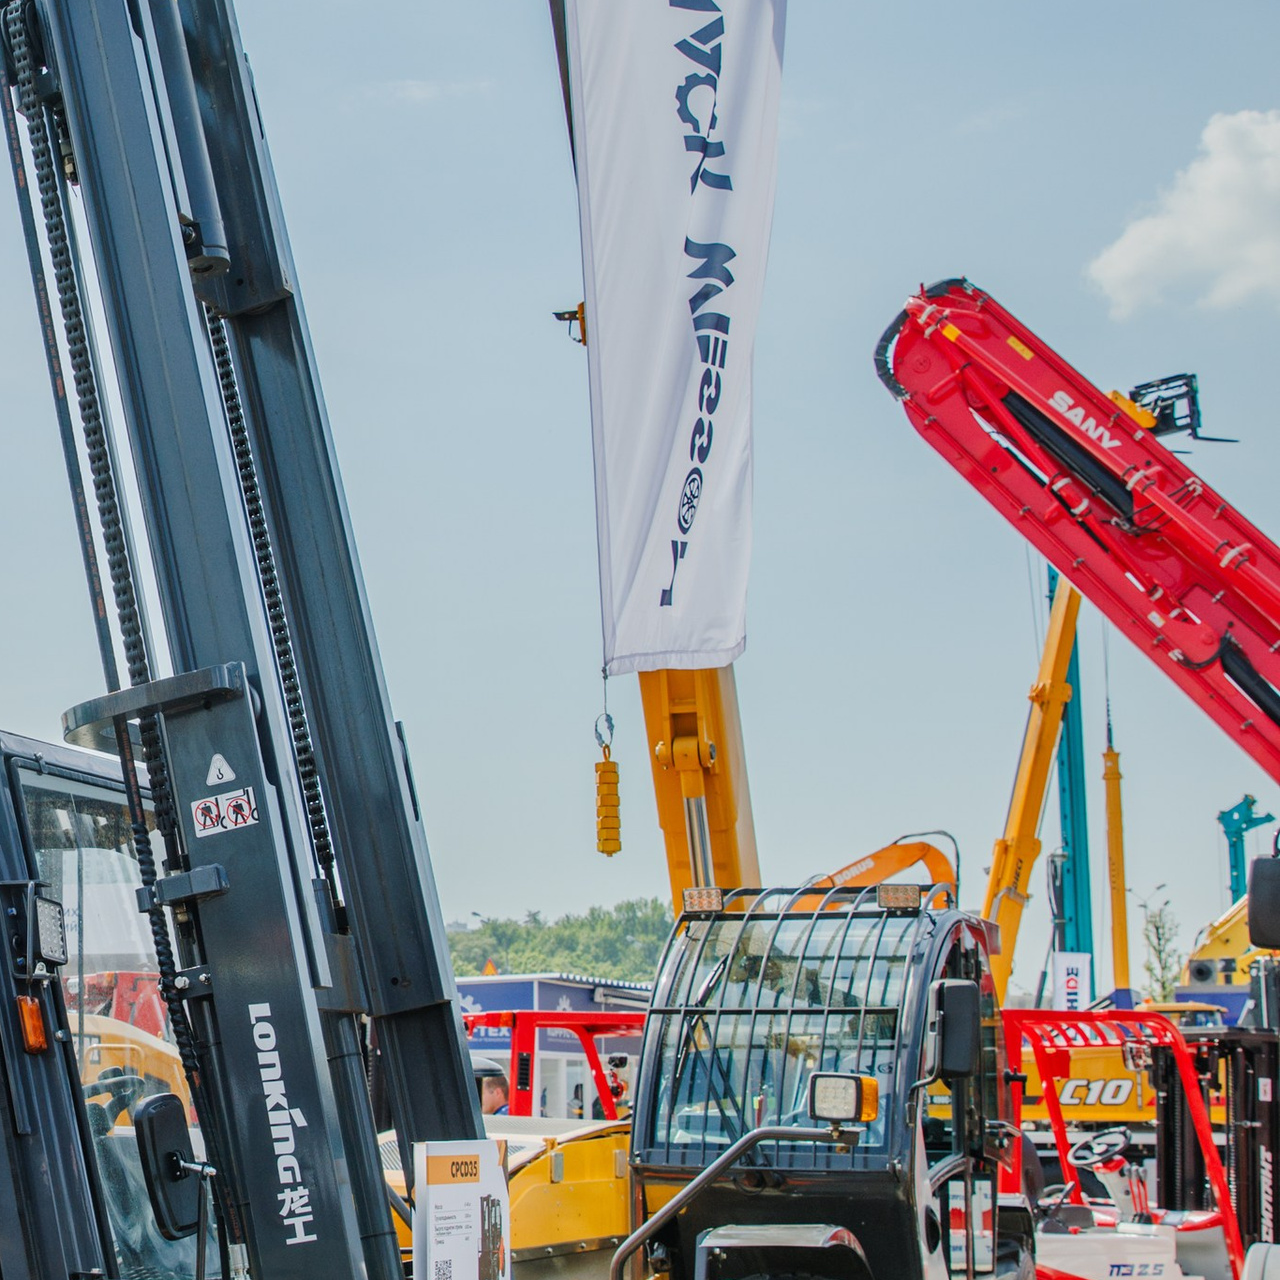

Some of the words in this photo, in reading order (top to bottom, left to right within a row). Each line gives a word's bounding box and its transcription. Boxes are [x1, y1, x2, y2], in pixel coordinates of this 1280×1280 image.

[1047, 390, 1122, 449] SANY
[833, 857, 875, 885] BORUS
[1059, 1078, 1134, 1106] C10
[450, 1161, 478, 1179] CPCD35
